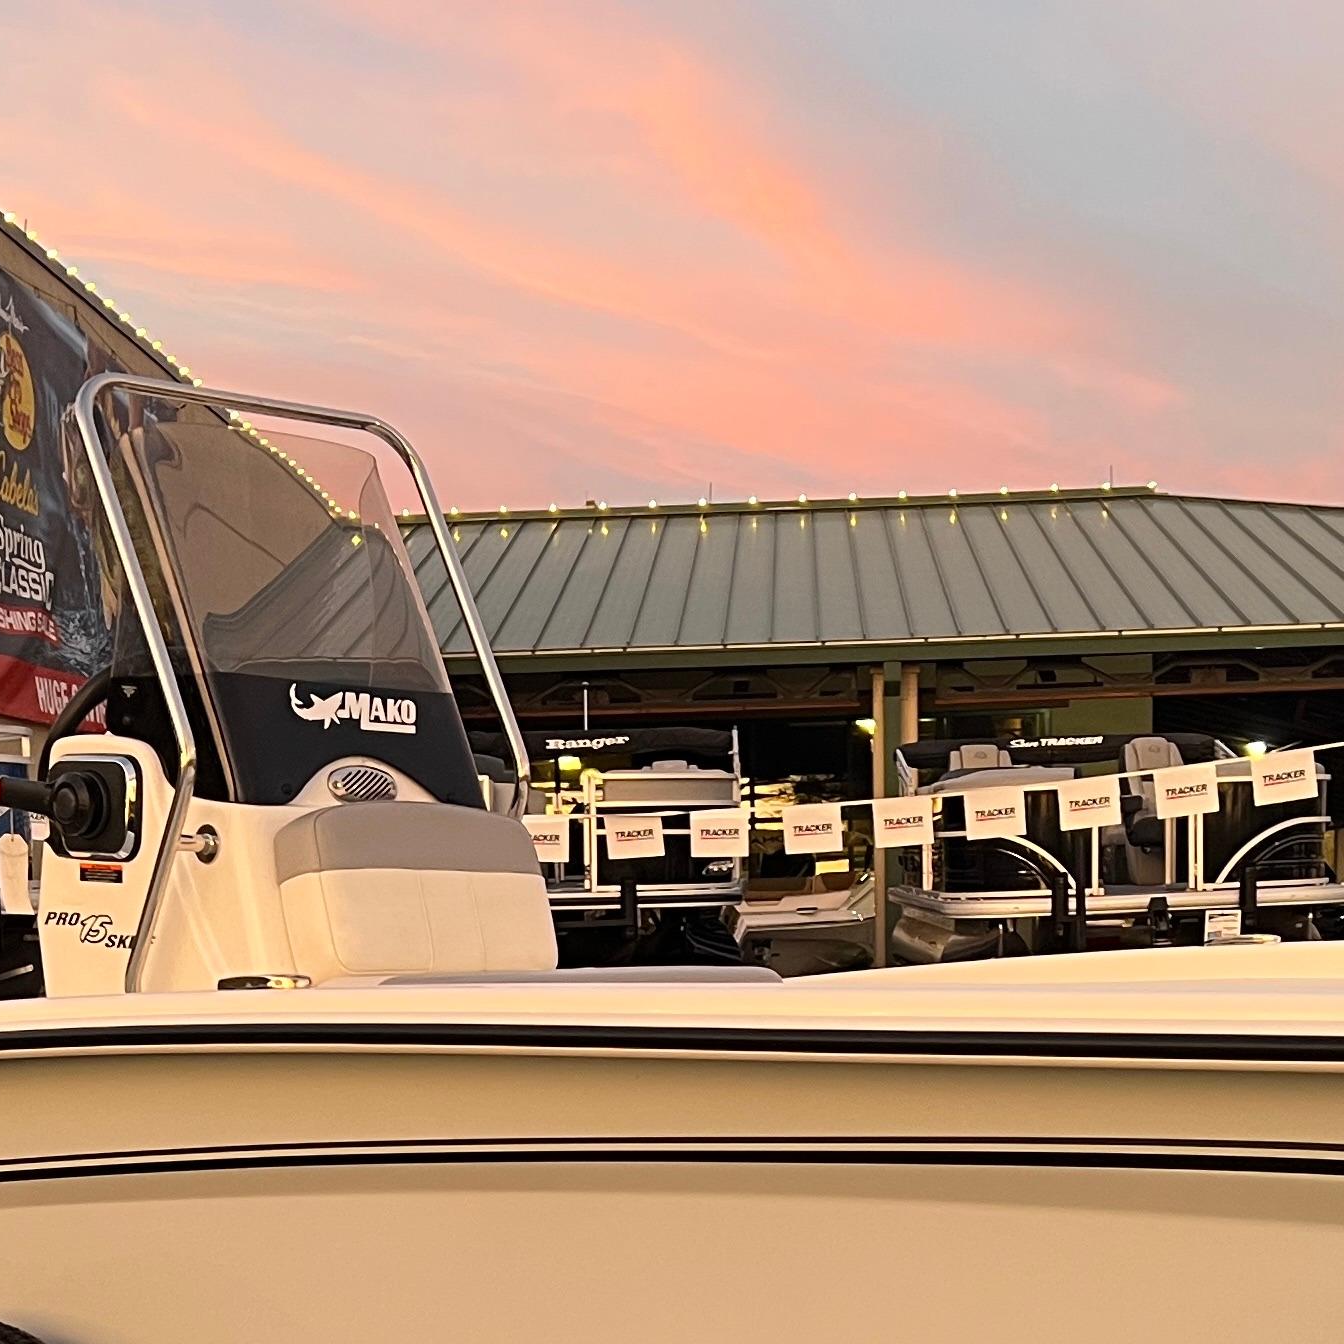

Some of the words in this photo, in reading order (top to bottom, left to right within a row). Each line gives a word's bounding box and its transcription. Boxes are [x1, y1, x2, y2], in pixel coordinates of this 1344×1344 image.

[34, 675, 70, 718] HUGE
[336, 691, 416, 734] MAKO
[545, 736, 630, 750] Ranger
[1039, 735, 1104, 747] TRACKER
[1262, 769, 1306, 784] TRACKER
[1165, 783, 1208, 797] TRACKER
[1069, 796, 1111, 809] TRACKER
[974, 806, 1016, 818] TRACKER
[883, 815, 924, 827] TRACKER
[615, 828, 654, 839] TRACKER
[700, 828, 740, 837] TRACKER
[793, 823, 833, 833] TRACKER
[532, 834, 560, 842] ACKER
[44, 911, 81, 926] PRO
[80, 914, 113, 944] 15
